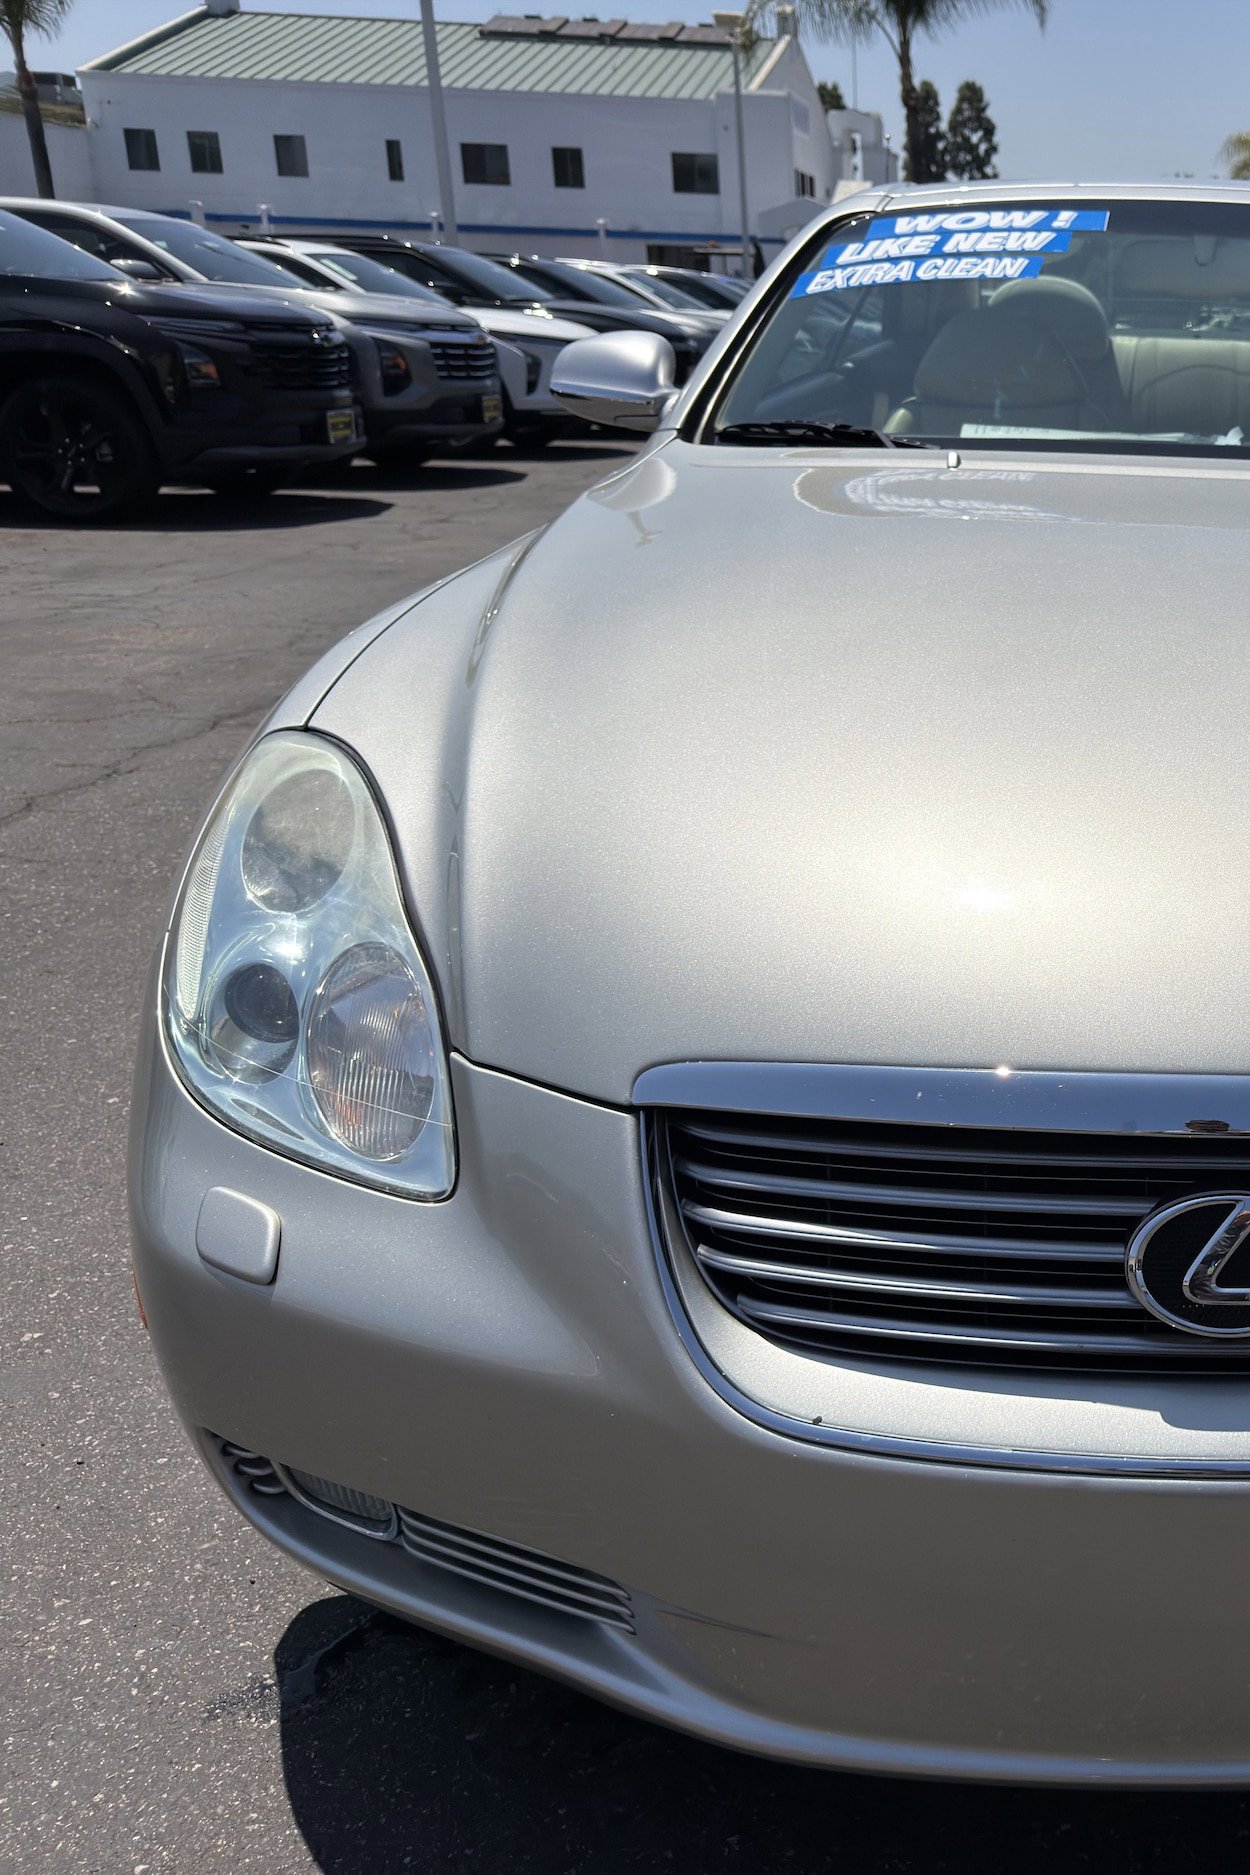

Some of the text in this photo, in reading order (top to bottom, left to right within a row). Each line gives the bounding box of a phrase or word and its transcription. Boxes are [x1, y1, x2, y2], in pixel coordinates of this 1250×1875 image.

[836, 231, 1057, 264] LIKE NEW
[806, 258, 1030, 294] EXTRA CLEAN
